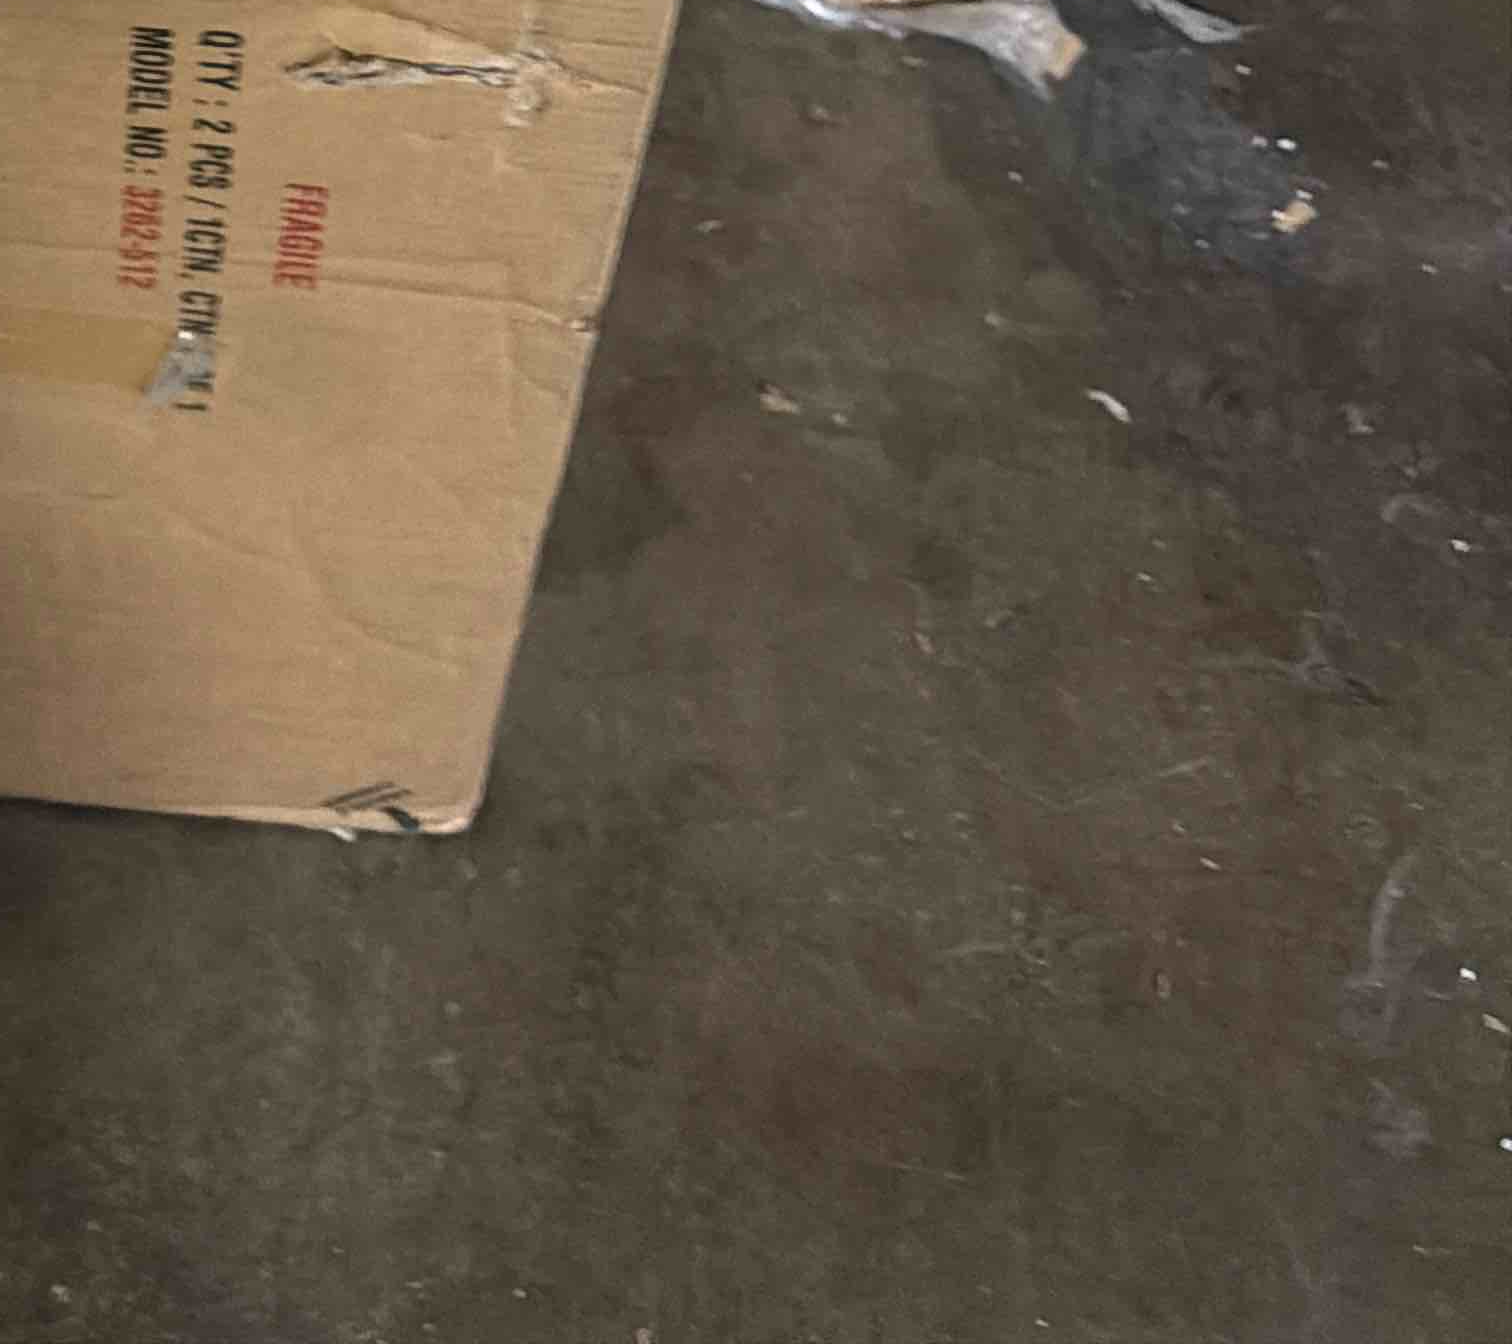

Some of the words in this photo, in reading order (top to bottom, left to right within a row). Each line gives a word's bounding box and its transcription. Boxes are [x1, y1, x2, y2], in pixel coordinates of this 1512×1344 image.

[126, 25, 176, 115] MODEL
[196, 28, 245, 92] Q'TY
[192, 118, 237, 135] 2
[188, 143, 235, 191] PCS
[272, 182, 330, 290] FRAGILE
[177, 290, 223, 337] CTN
